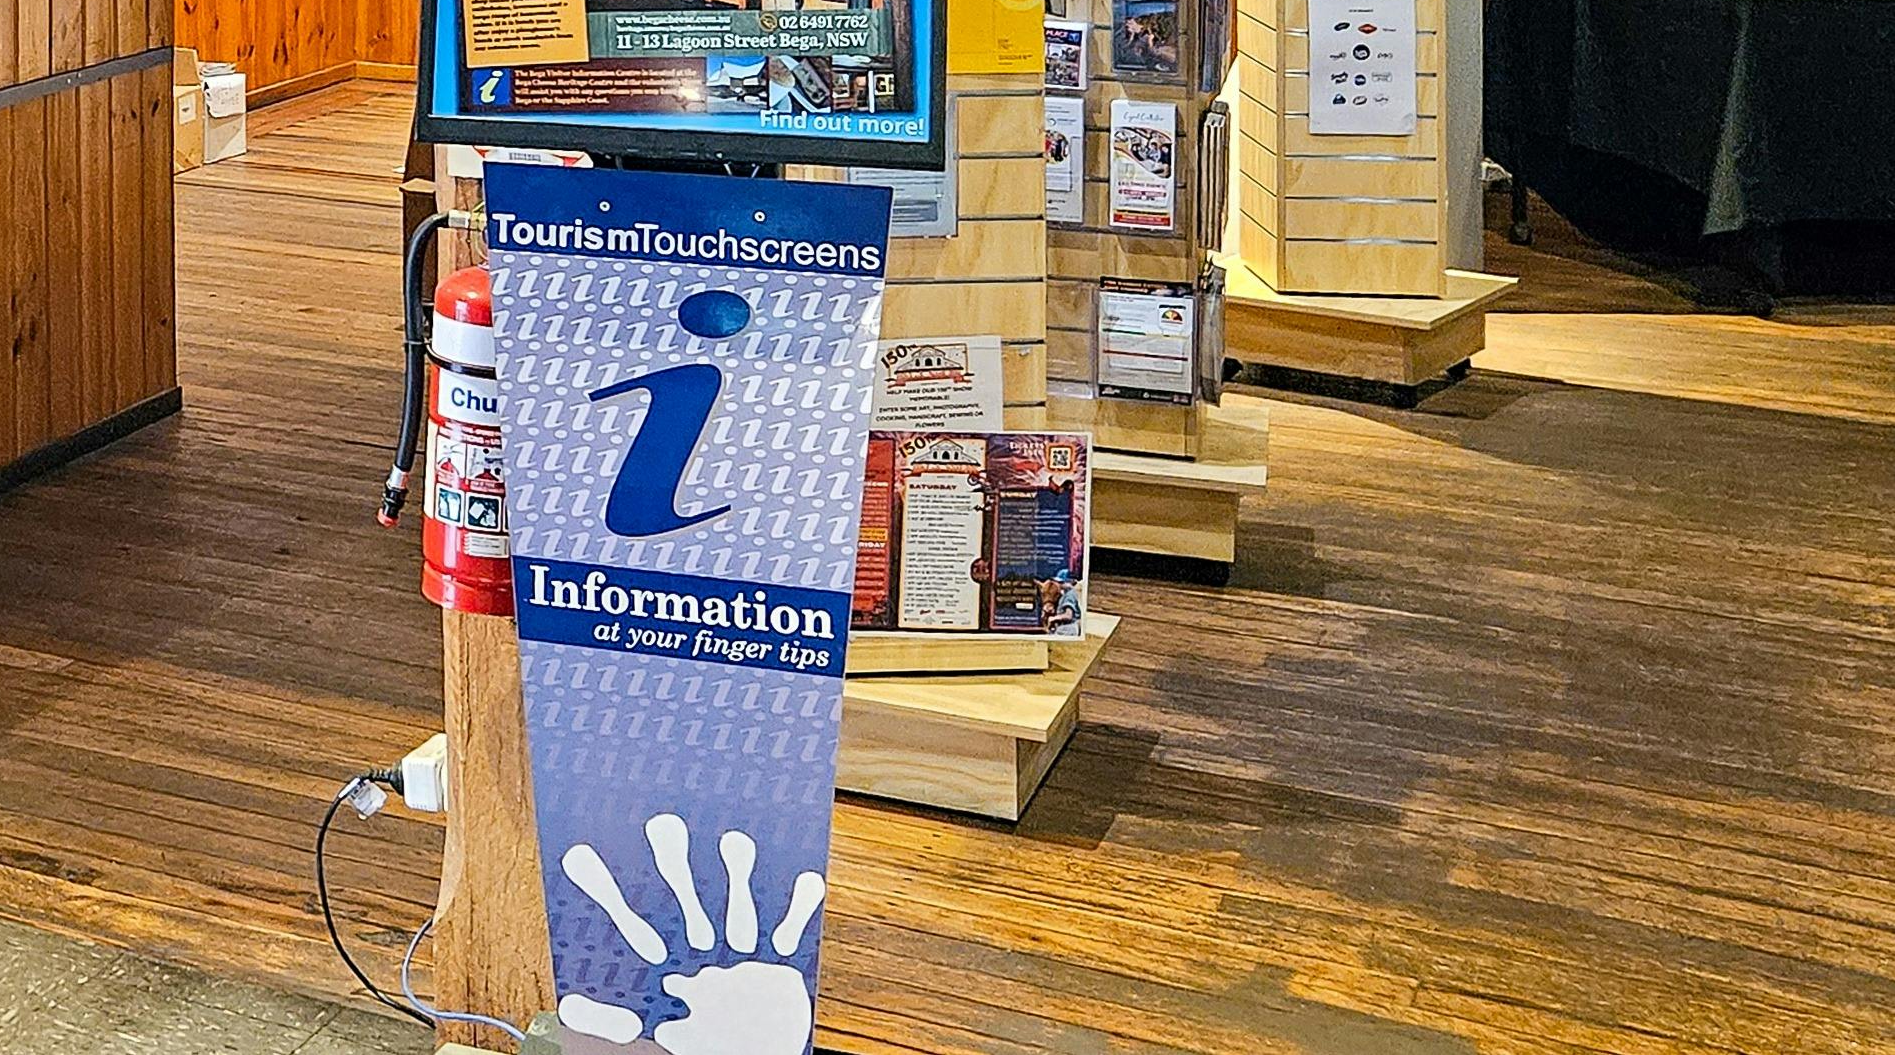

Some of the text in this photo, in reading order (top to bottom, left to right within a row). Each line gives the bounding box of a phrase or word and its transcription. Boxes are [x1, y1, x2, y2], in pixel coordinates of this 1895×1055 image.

[779, 16, 798, 30] 02
[662, 33, 722, 53] Lagoon
[724, 32, 777, 48] Street
[779, 32, 824, 51] Bega,
[826, 32, 869, 47] NSW
[760, 109, 925, 136] Find out more!
[491, 213, 881, 270] TourismTouchscreens
[450, 387, 498, 414] Chu
[529, 564, 835, 639] Information
[593, 622, 831, 669] at your finger tips
